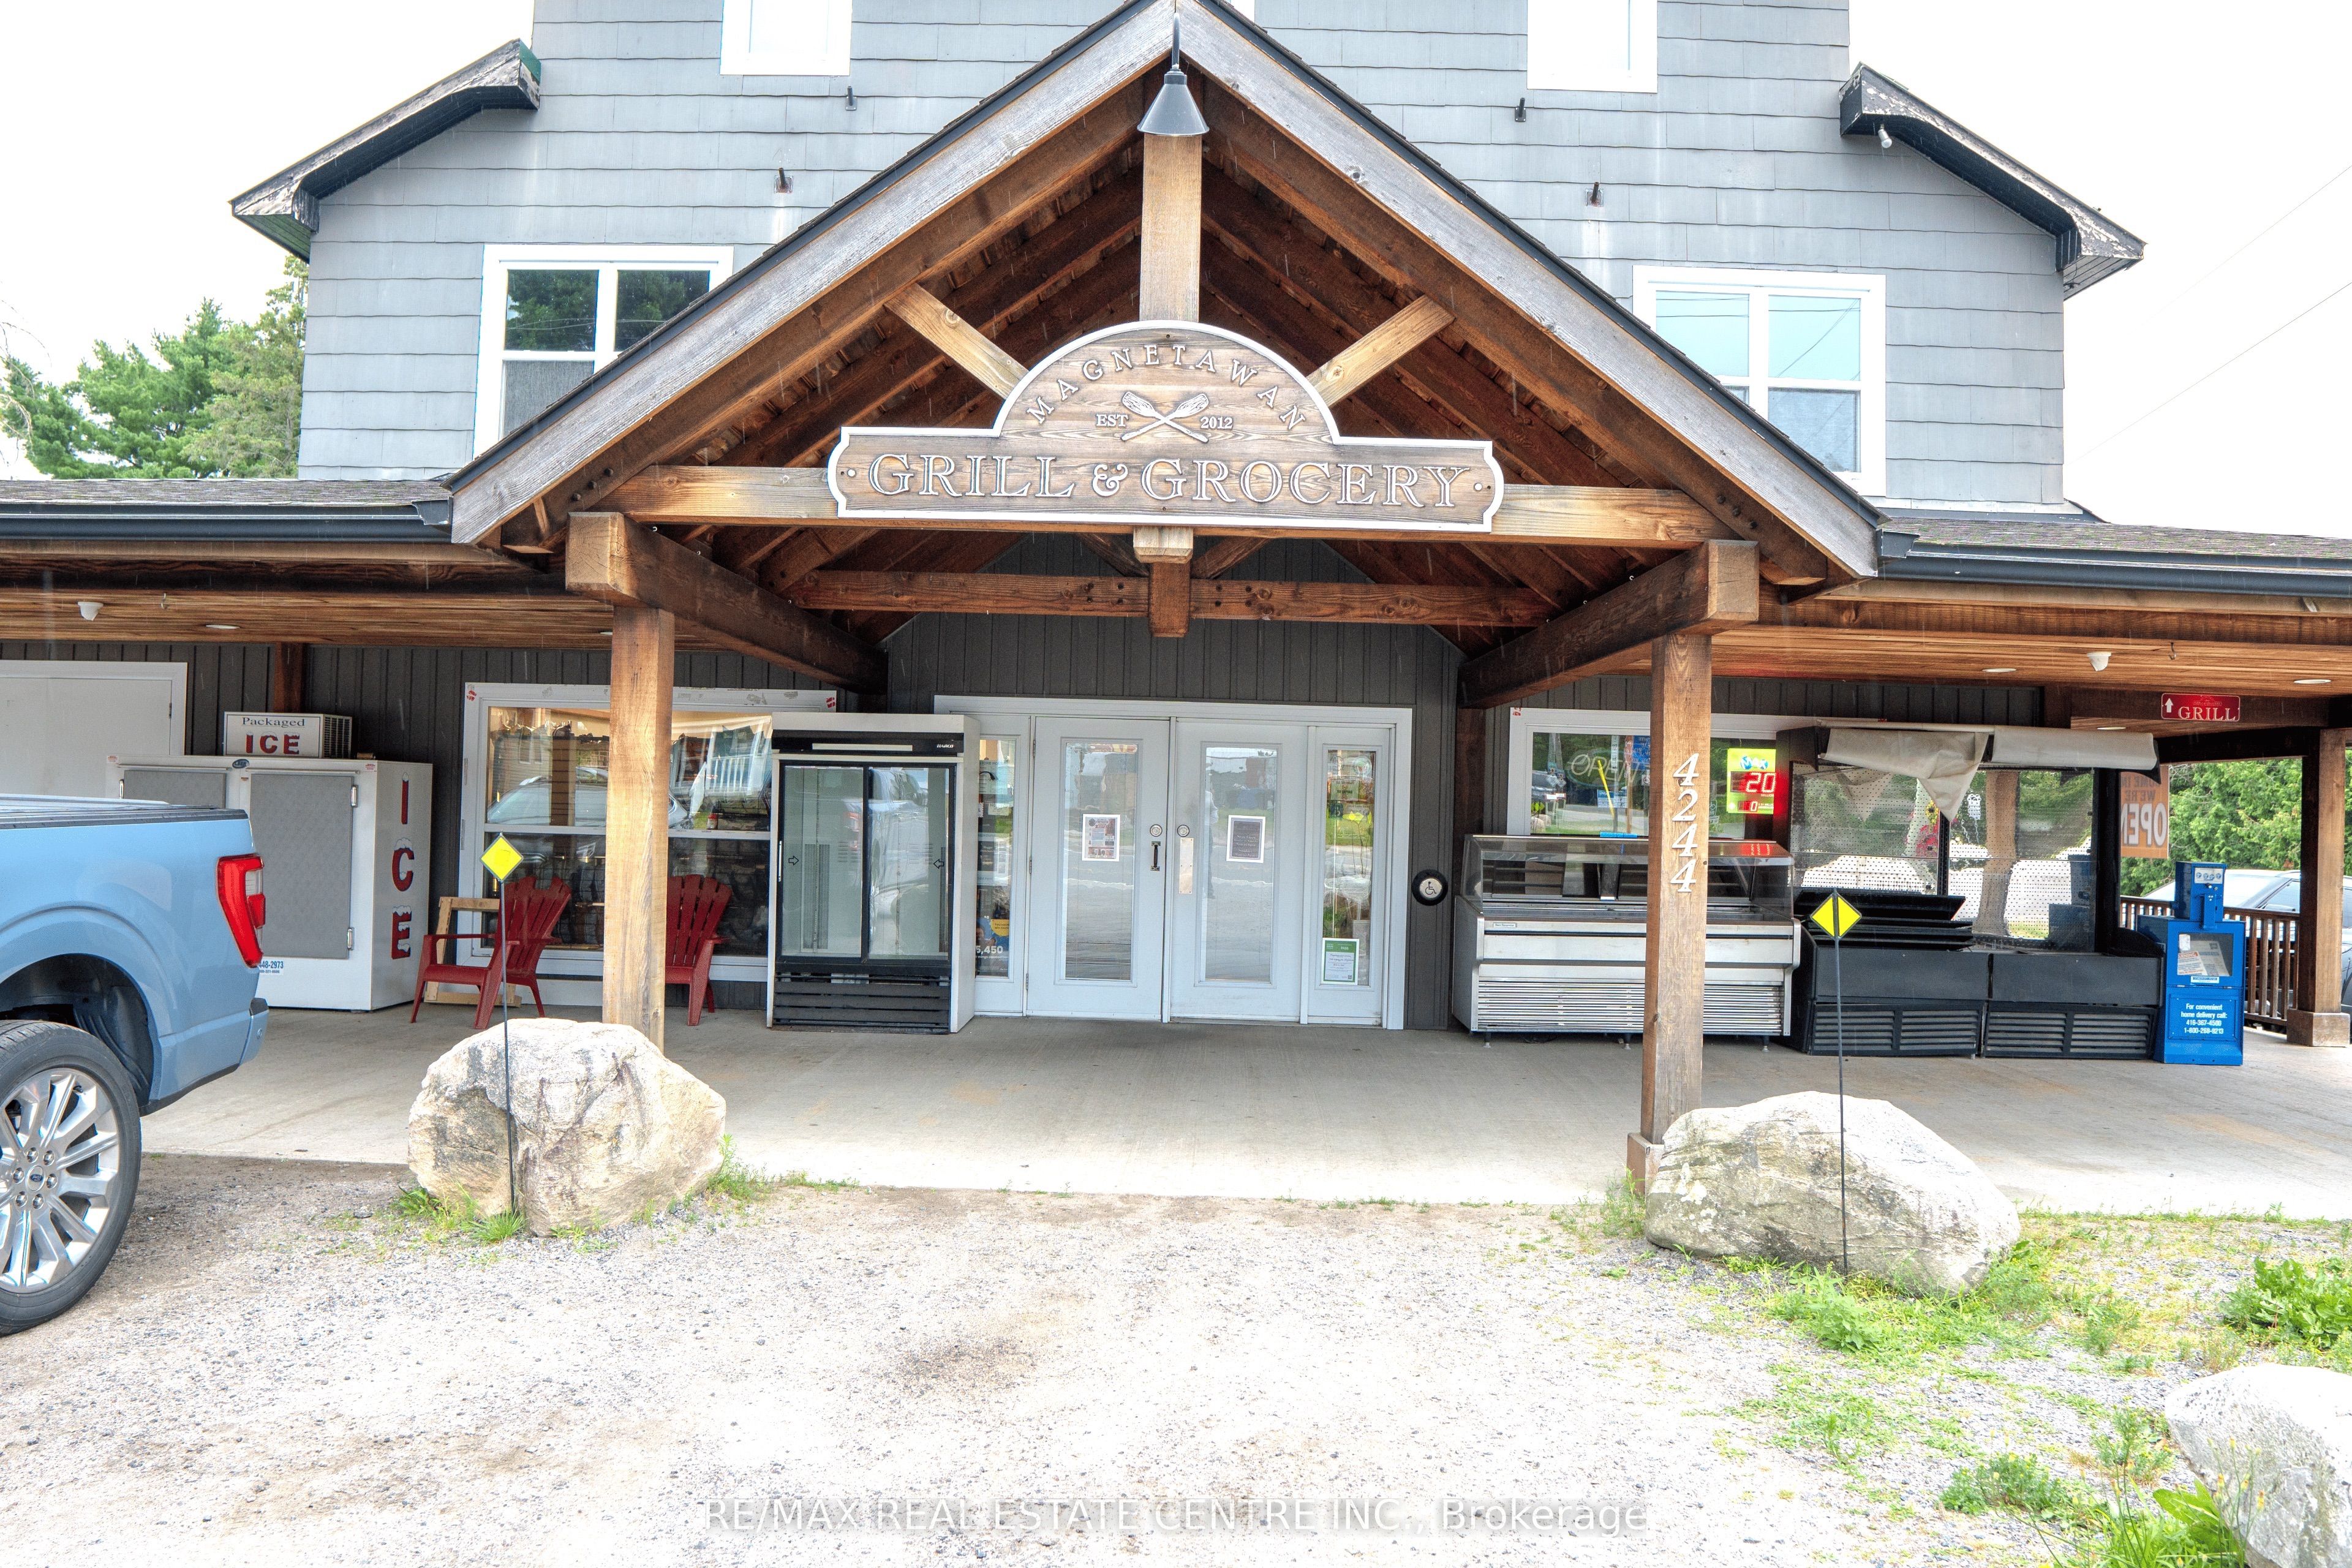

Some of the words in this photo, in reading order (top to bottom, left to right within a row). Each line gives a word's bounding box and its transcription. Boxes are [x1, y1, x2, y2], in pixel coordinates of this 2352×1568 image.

[1027, 344, 1305, 430] MAGNETAWAN
[1096, 414, 1128, 428] EST
[1200, 417, 1234, 429] 2012
[869, 453, 1076, 497] GRILL
[1091, 463, 1128, 497] &
[1141, 458, 1470, 507] GROCERY
[242, 717, 305, 728] Packaged
[2178, 706, 2236, 721] GRILL
[246, 732, 300, 755] ICE
[1567, 753, 1641, 783] OPEN
[1746, 772, 1776, 793] 20
[1670, 753, 1699, 892] 4244
[391, 772, 415, 959] ICE
